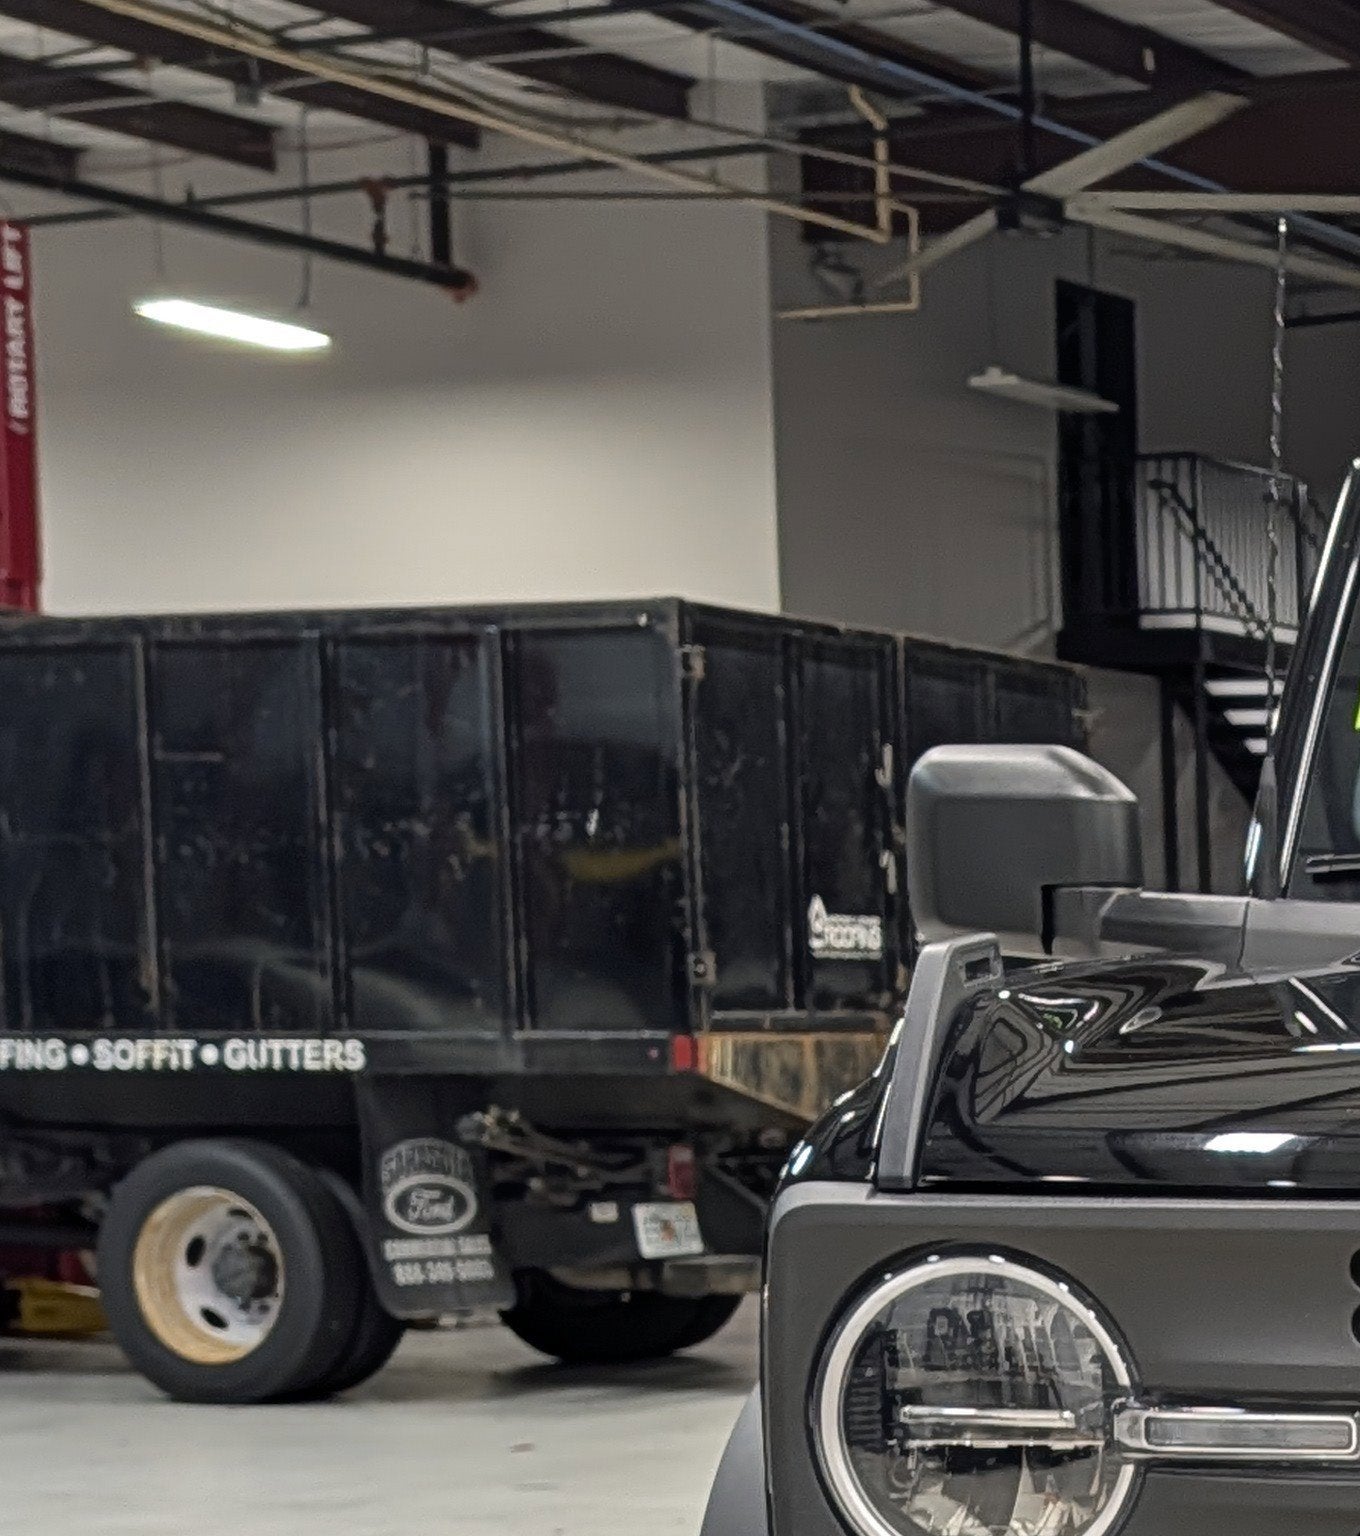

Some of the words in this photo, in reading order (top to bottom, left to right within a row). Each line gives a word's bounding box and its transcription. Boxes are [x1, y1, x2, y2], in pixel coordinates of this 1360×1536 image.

[93, 1039, 198, 1071] SOFFIT
[223, 1039, 367, 1071] GUTTERS
[407, 1187, 456, 1222] Ford
